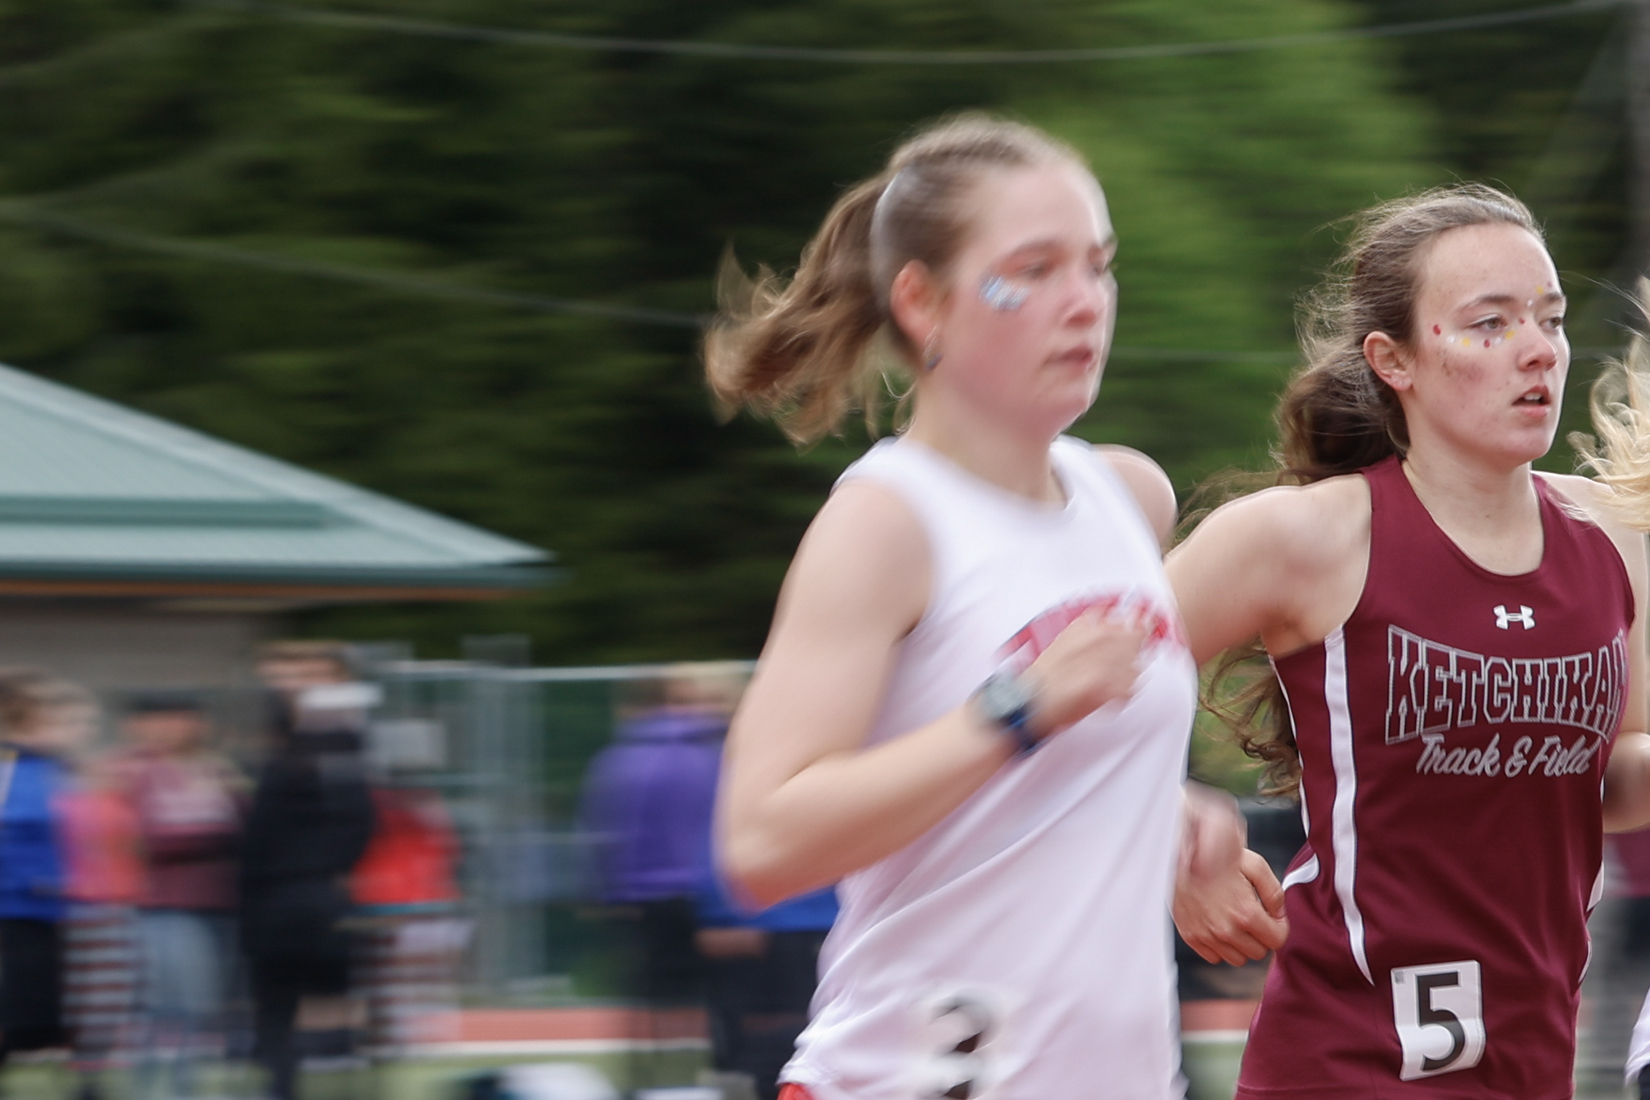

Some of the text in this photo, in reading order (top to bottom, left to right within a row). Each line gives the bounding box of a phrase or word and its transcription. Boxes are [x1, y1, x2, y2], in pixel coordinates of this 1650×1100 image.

[1416, 733, 1602, 778] Track & Field
[1416, 971, 1466, 1071] 5
